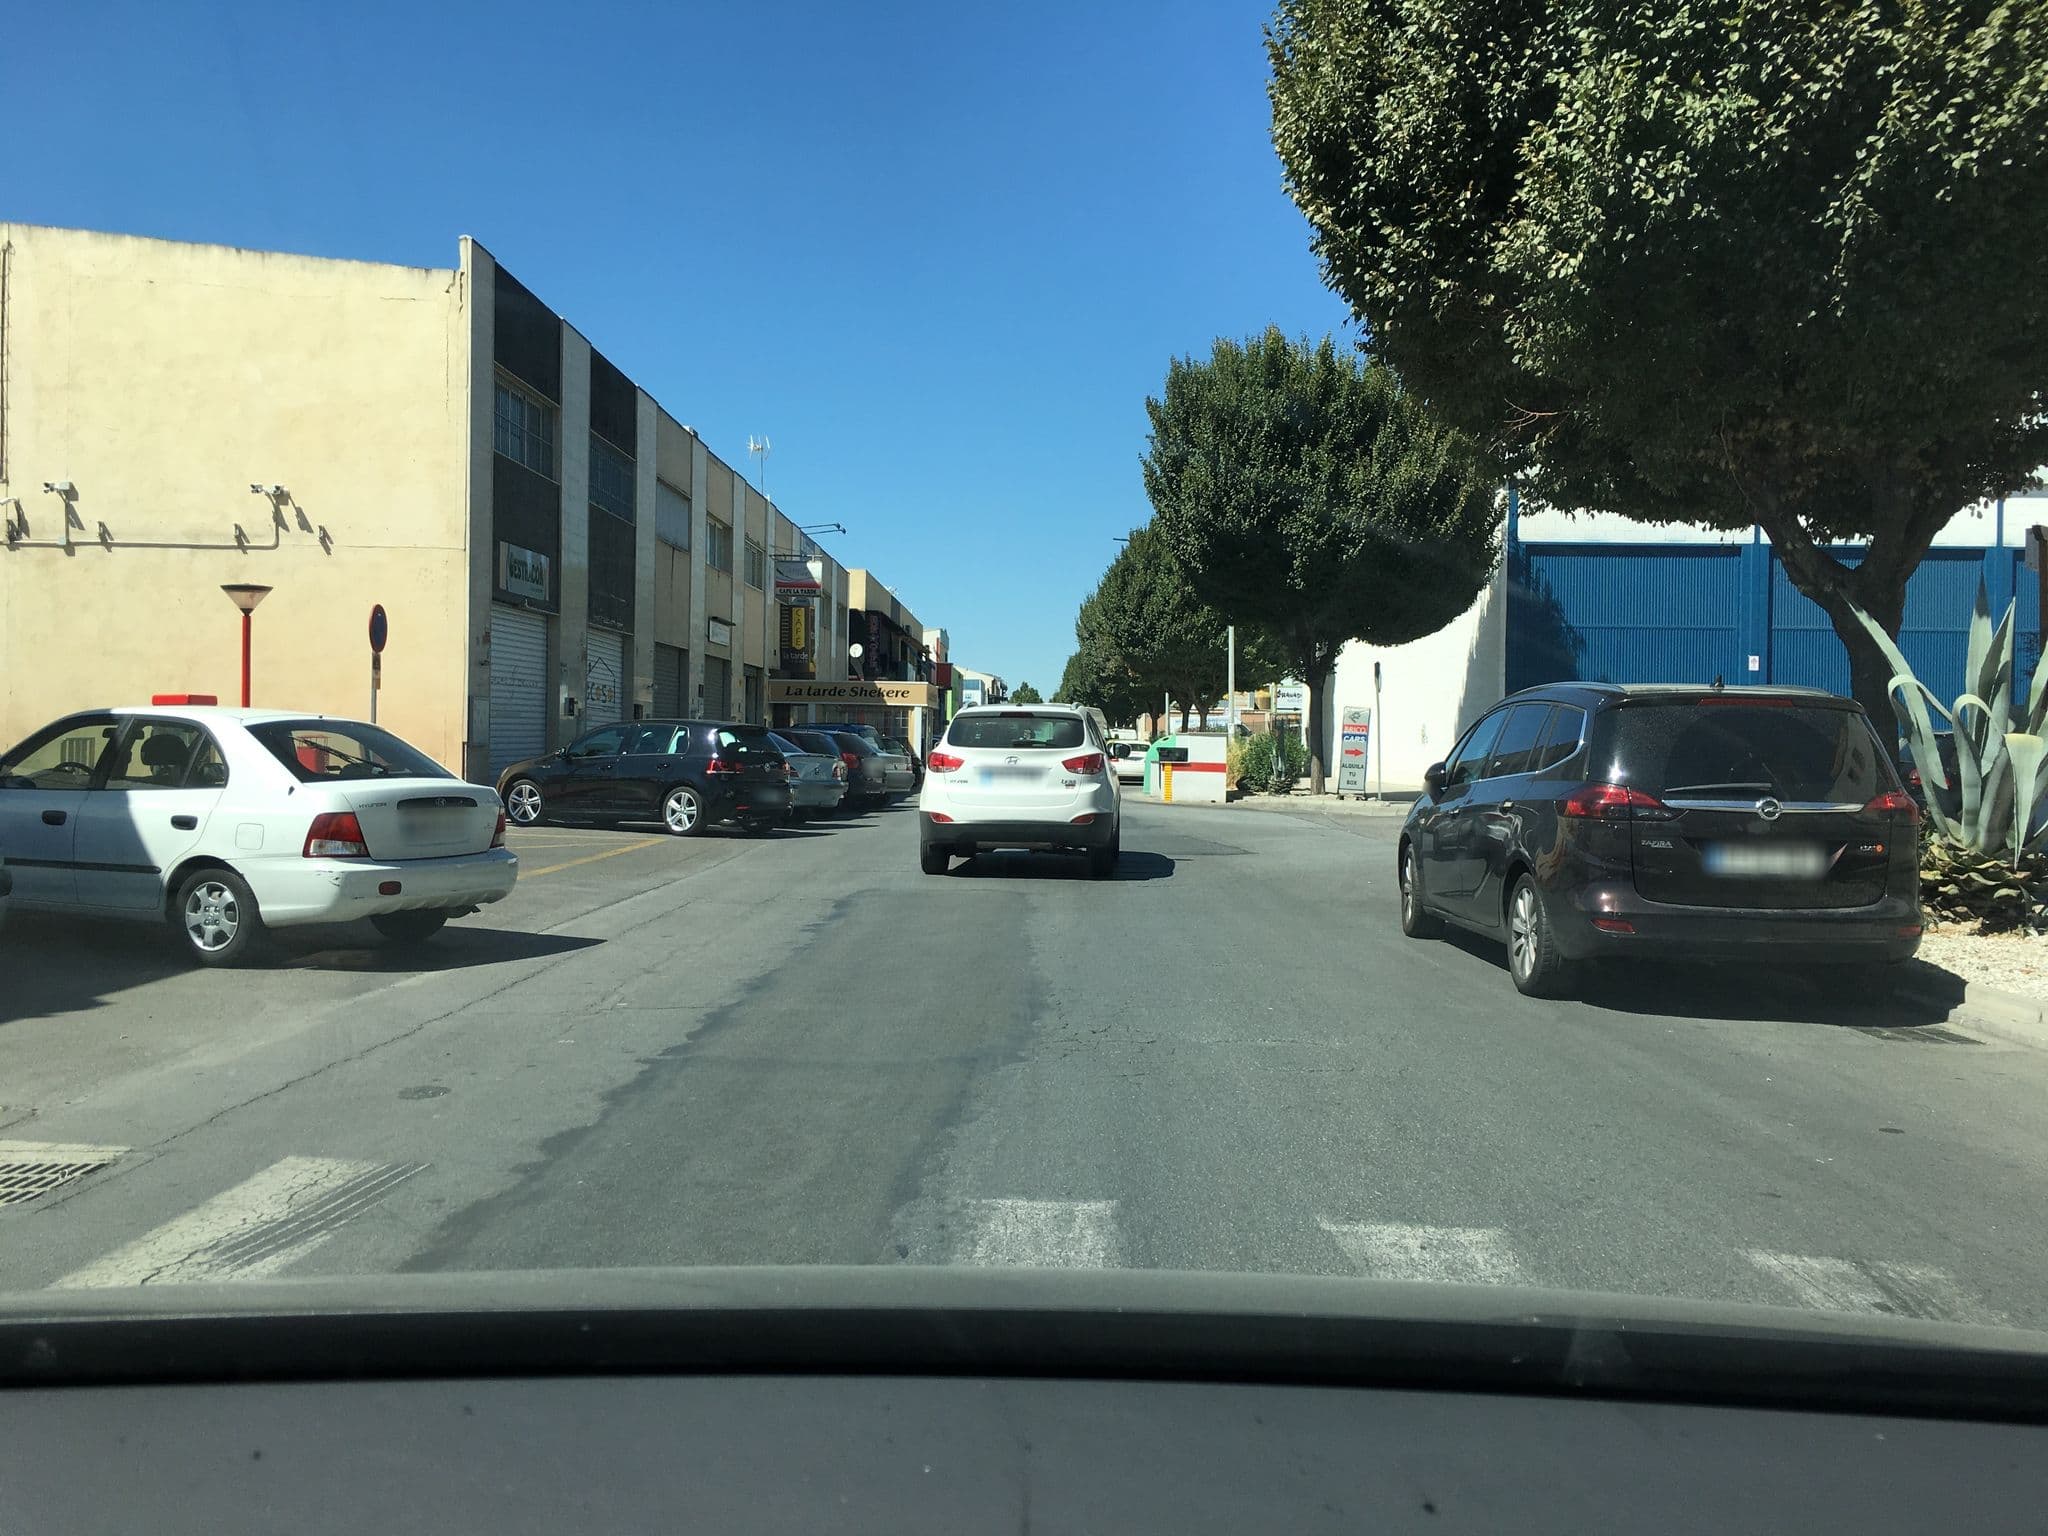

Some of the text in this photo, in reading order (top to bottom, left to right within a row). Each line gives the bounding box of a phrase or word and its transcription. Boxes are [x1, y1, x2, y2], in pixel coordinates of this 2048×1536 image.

[790, 651, 808, 660] tarde
[785, 685, 910, 698] La tarde Shekere
